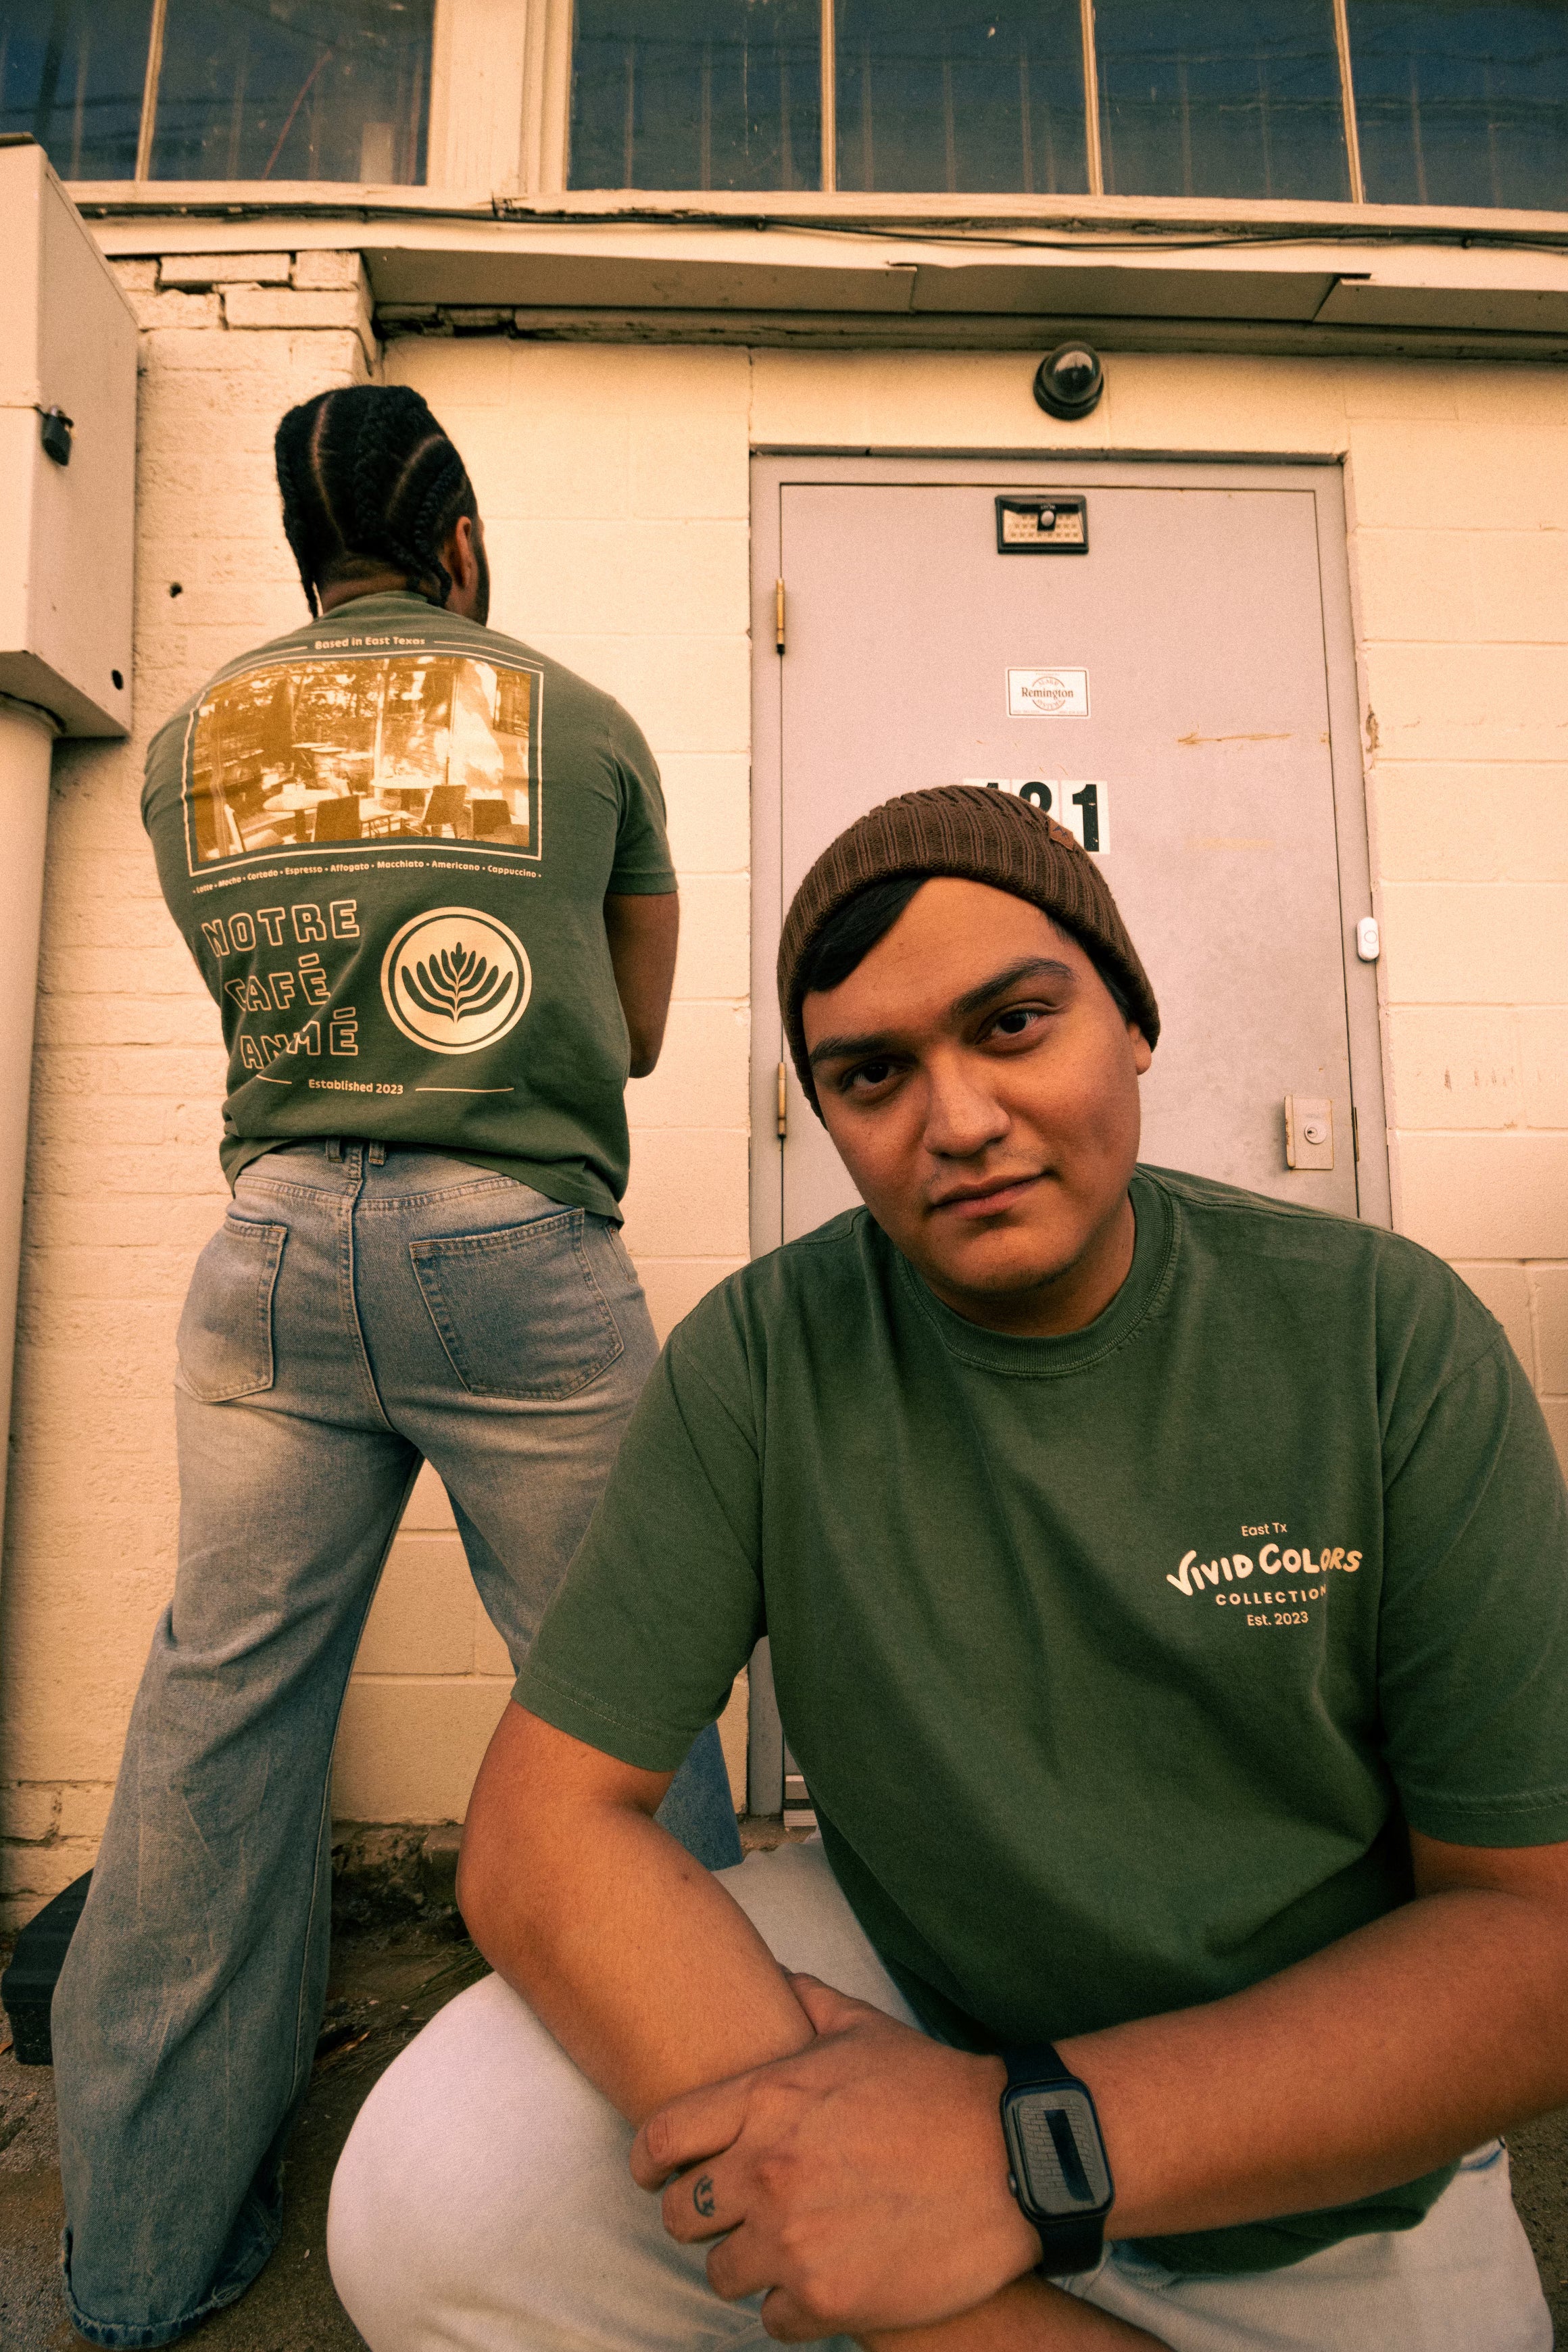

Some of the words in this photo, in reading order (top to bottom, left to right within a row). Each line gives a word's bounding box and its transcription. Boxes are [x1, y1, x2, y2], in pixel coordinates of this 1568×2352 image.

[314, 638, 349, 650] Based
[351, 637, 363, 646] in
[365, 636, 391, 645] East
[393, 636, 426, 645] Texas
[1021, 687, 1074, 700] Remington
[196, 883, 214, 894] Latte
[218, 875, 242, 888] Mocha
[247, 869, 278, 881] Cortado
[285, 865, 323, 876] Espresso
[330, 862, 370, 873] Affogato
[376, 860, 424, 869] Macchiato
[431, 860, 481, 872] Americano
[487, 864, 537, 879] Cappuccino
[201, 899, 361, 958] NOTRE
[308, 1079, 373, 1093] Established
[376, 1083, 404, 1095] 2023
[1240, 1523, 1271, 1537] East
[1272, 1522, 1288, 1533] Tx
[1166, 1550, 1254, 1596] VIVID
[1258, 1543, 1363, 1575] COLORS
[1215, 1584, 1327, 1606] COLLECTION
[1246, 1614, 1272, 1627] Est.
[1273, 1611, 1310, 1625] 2023
